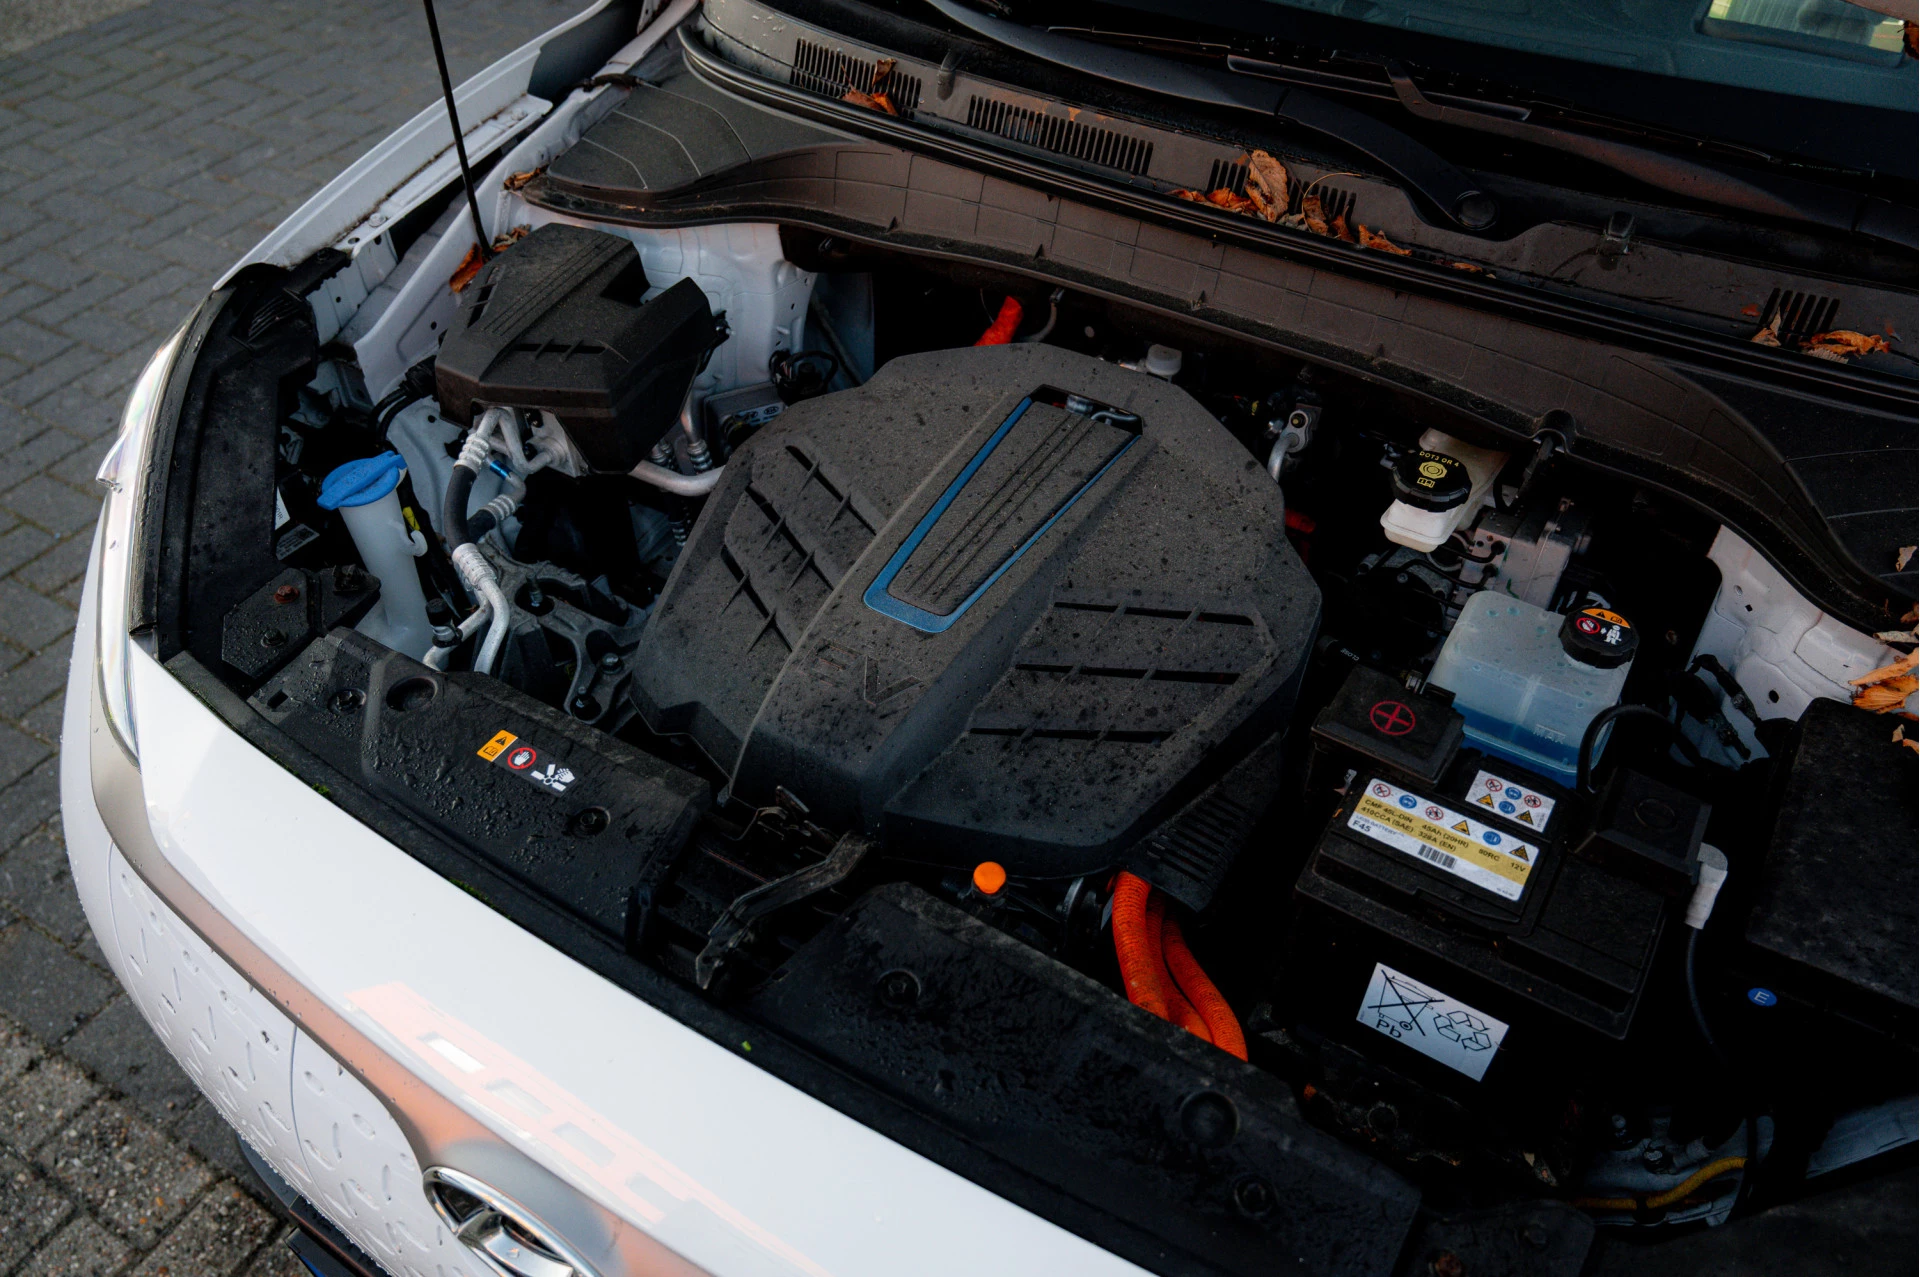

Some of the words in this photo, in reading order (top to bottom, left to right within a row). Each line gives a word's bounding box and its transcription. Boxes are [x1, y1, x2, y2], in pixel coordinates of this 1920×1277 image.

[1419, 450, 1440, 461] DOT3
[1441, 457, 1453, 465] OR
[1533, 726, 1567, 744] MAX
[1352, 820, 1372, 832] F45
[1361, 806, 1391, 823] 410CCA
[1392, 819, 1414, 833] (SAE)
[1439, 839, 1456, 852] (EN)
[1421, 824, 1442, 837] 45Ah
[1443, 832, 1469, 848] (20HR)
[1510, 862, 1526, 872] 12V
[1754, 991, 1770, 1004] E
[1376, 1019, 1402, 1039] Pb
